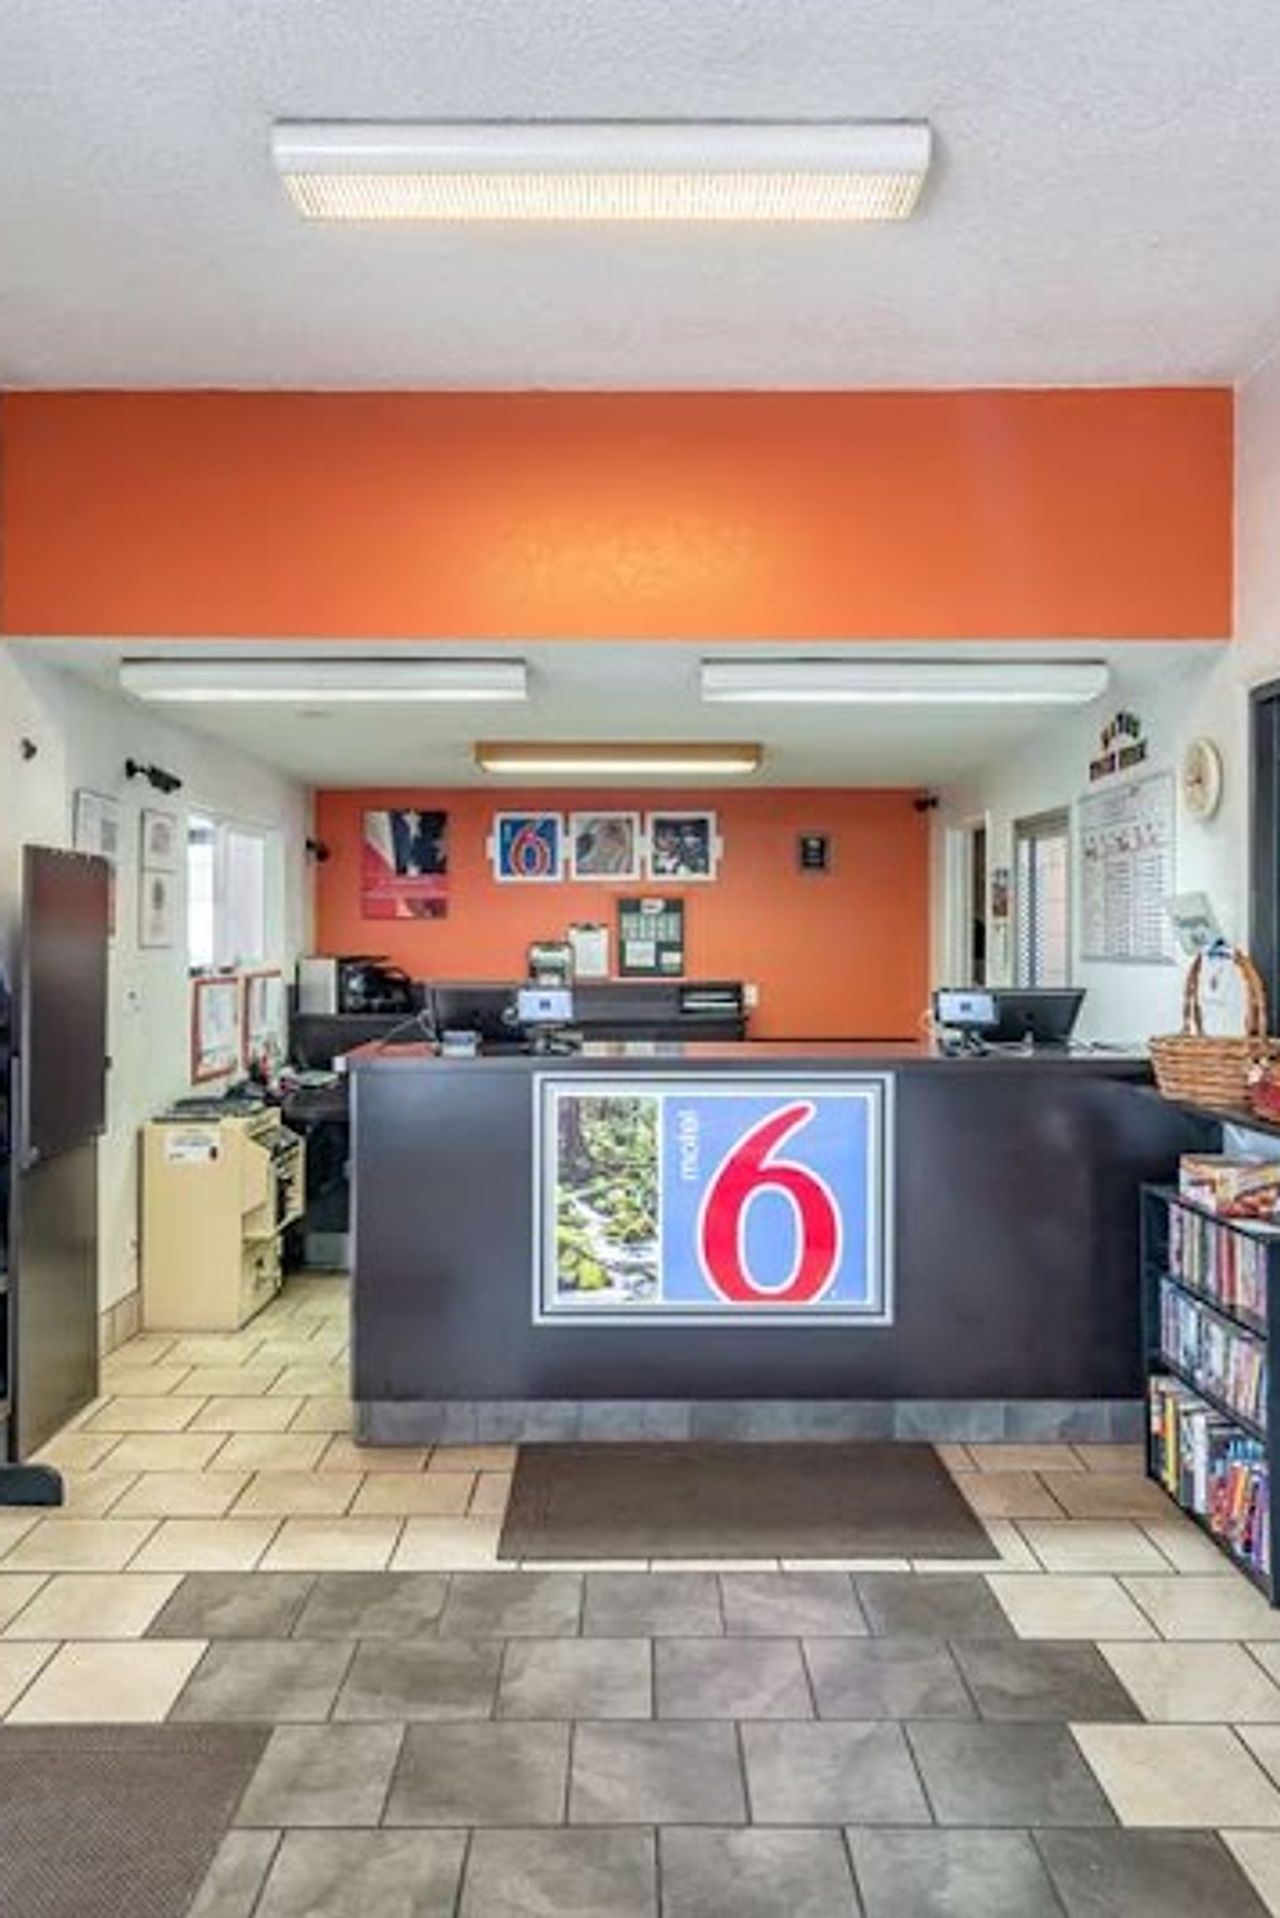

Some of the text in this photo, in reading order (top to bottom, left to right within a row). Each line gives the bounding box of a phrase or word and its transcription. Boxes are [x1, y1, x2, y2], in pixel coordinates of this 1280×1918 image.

[508, 818, 552, 876] 6
[677, 1109, 698, 1181] motel
[698, 1100, 843, 1304] 6
